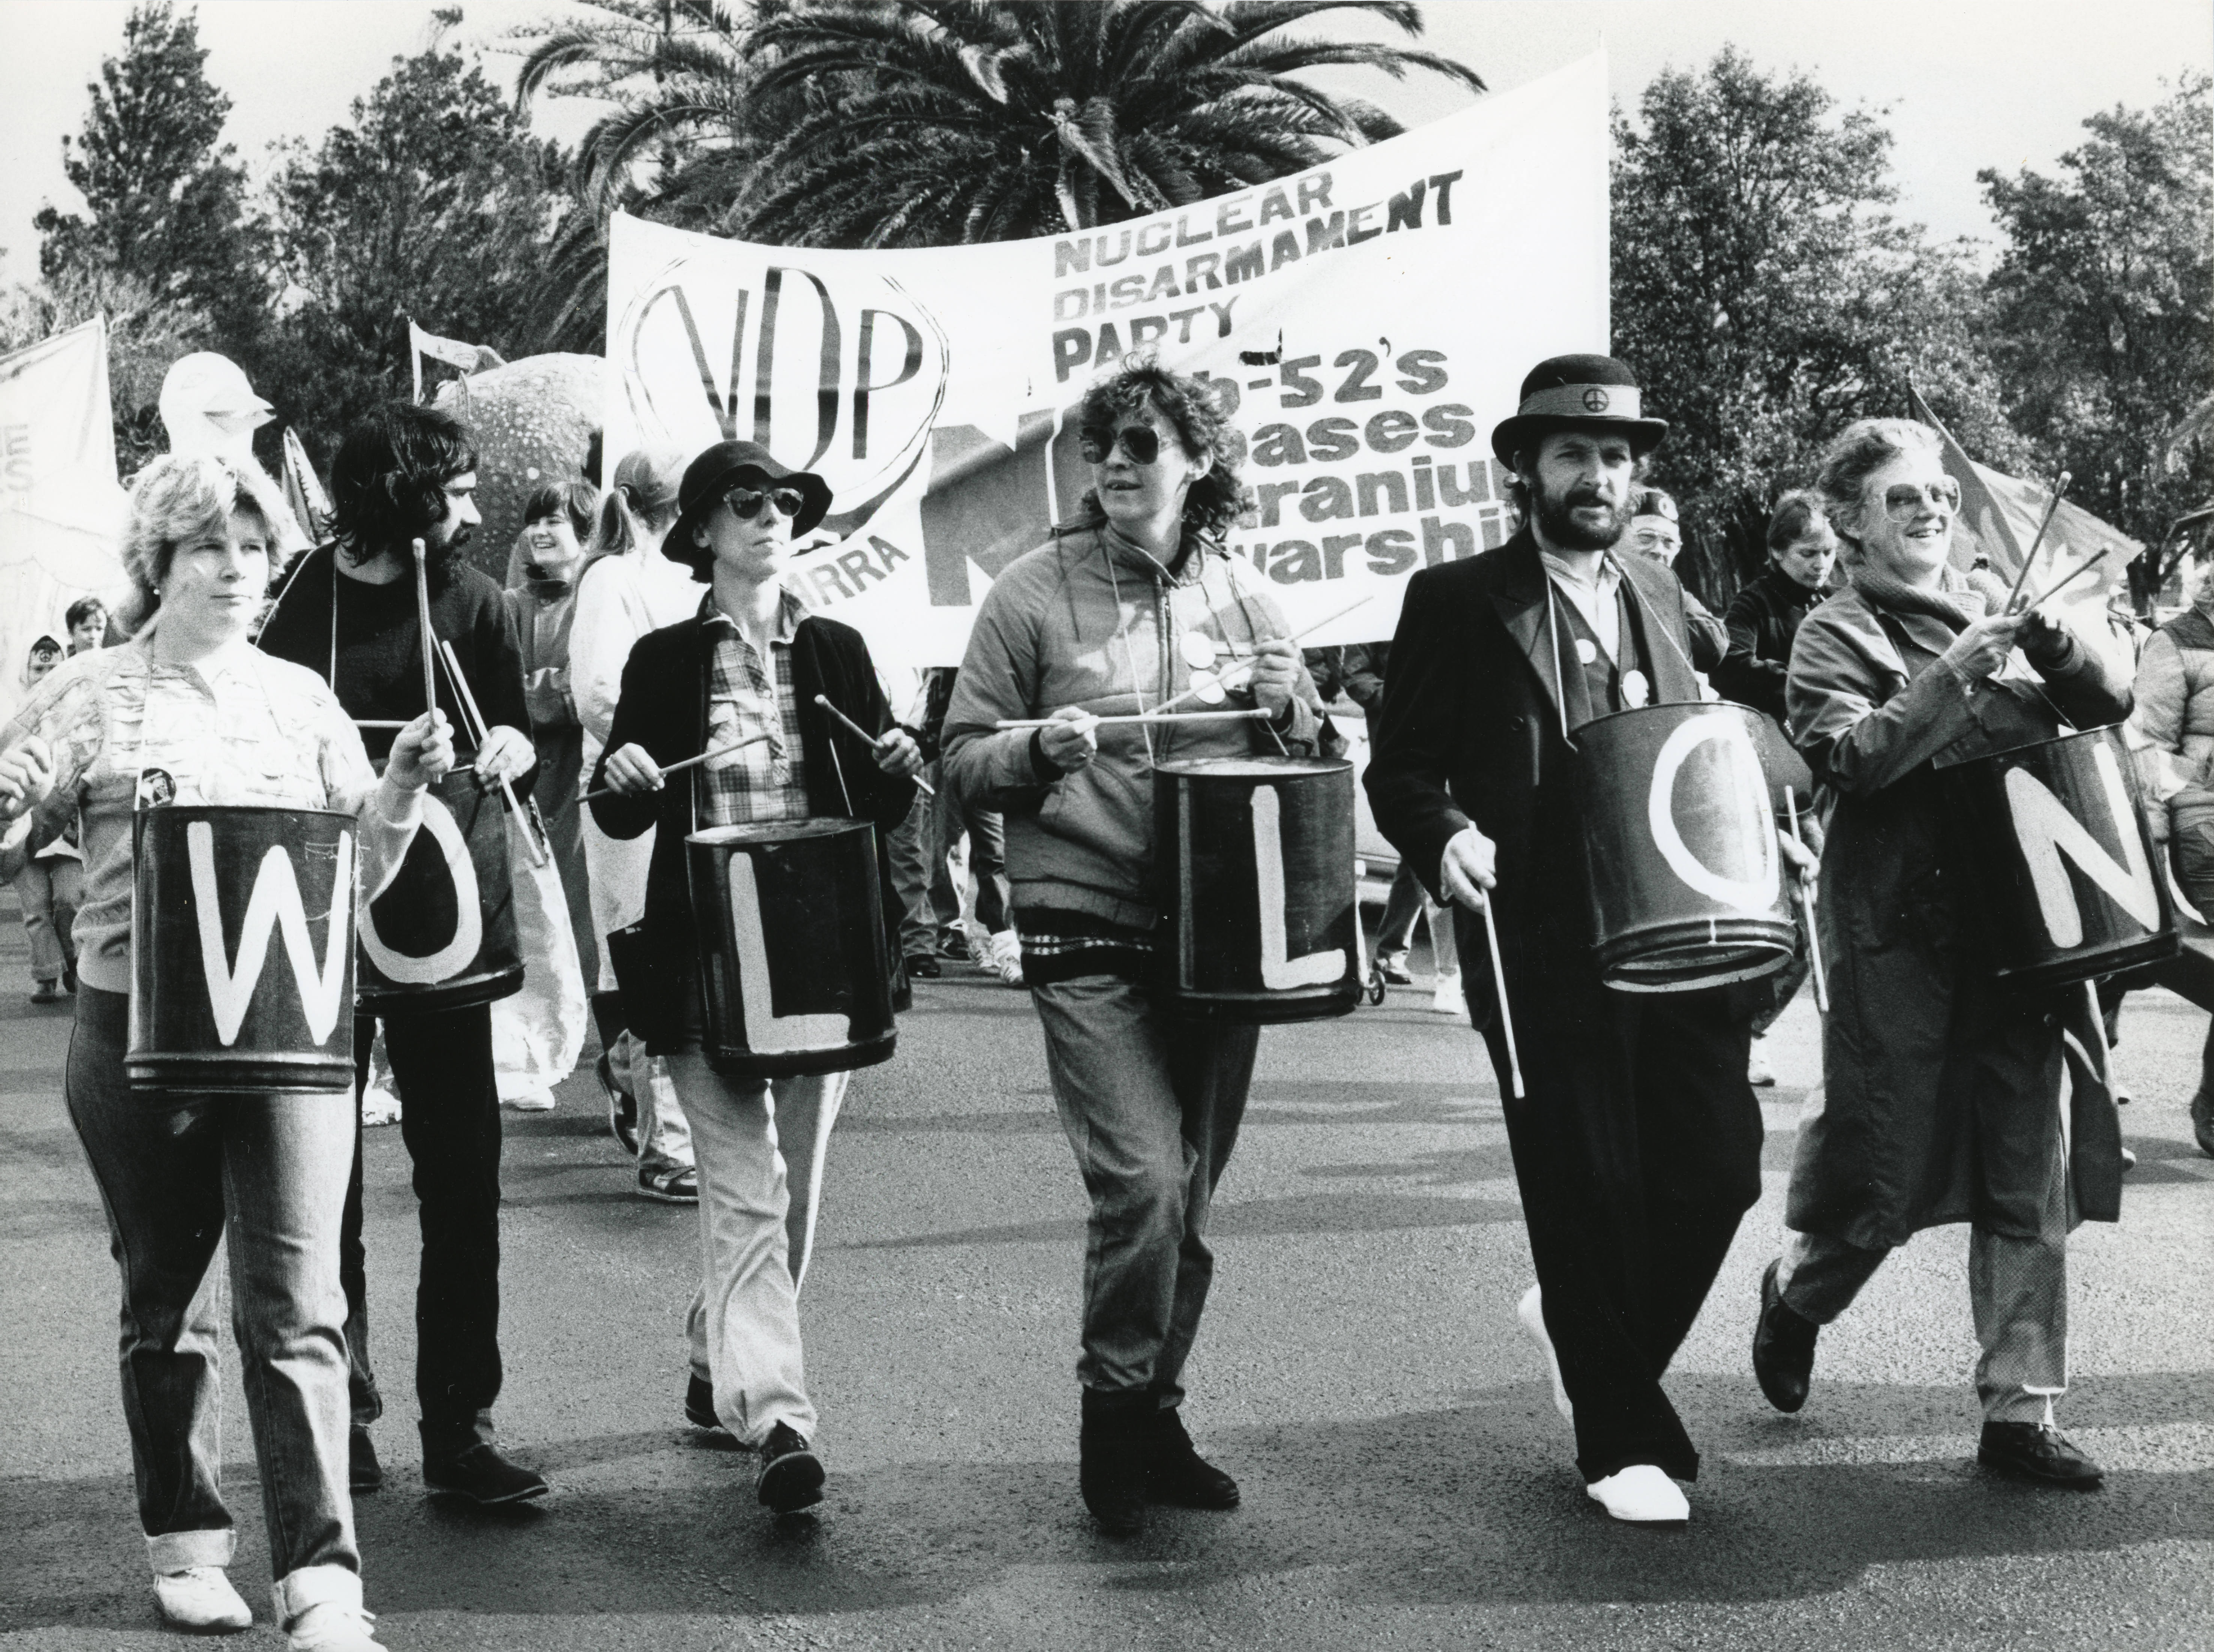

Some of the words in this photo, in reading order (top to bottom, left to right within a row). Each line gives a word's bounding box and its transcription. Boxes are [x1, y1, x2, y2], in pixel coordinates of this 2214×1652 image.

[1053, 169, 1464, 322] DISARMAMENT
[1054, 171, 1333, 278] NUCLEAR
[1052, 294, 1241, 383] PARTY
[1234, 507, 1516, 585] arshi
[356, 793, 482, 984] O
[1250, 784, 1347, 990] L
[1649, 712, 1781, 915] O
[2005, 741, 2160, 948] N
[187, 821, 352, 1047] W
[728, 851, 850, 1054] L
